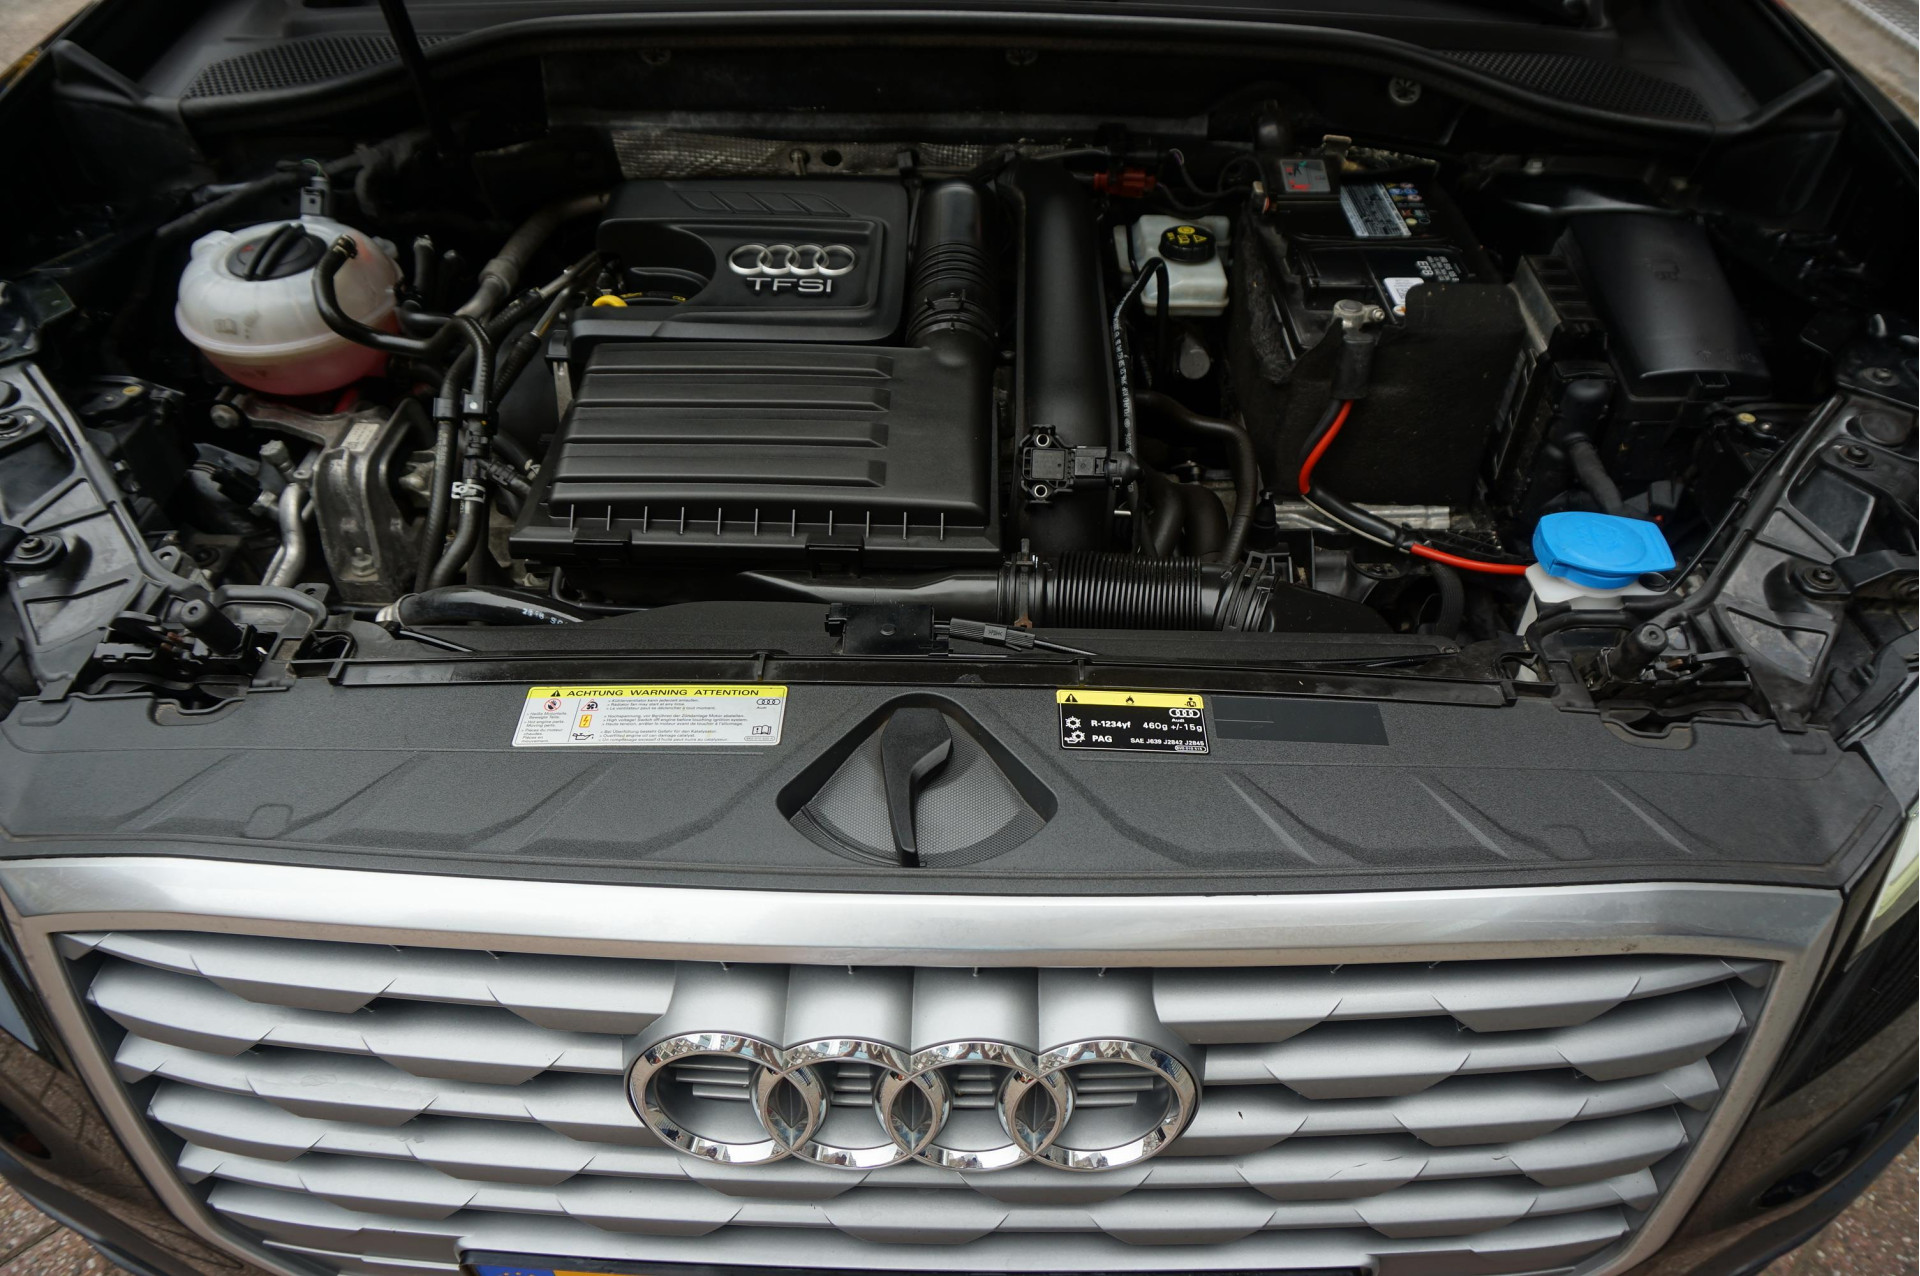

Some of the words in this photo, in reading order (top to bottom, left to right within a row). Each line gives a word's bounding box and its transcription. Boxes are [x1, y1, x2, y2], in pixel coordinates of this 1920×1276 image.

[1416, 260, 1434, 277] EFB
[746, 277, 832, 293] TFSI
[1090, 719, 1131, 729] R-1234yf
[1142, 722, 1168, 731] 460g
[1092, 734, 1114, 743] PAG
